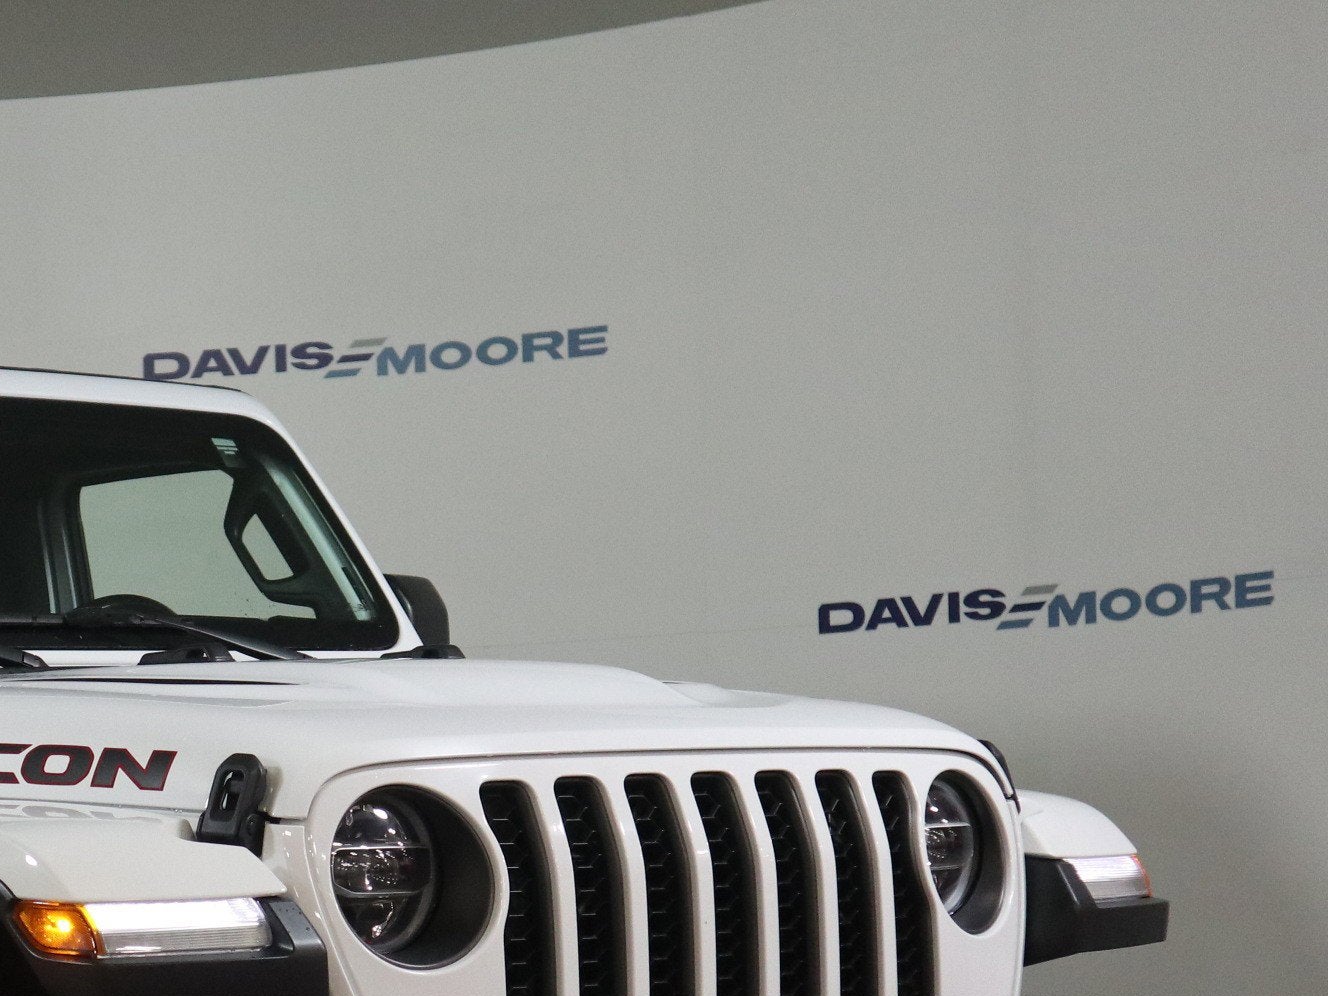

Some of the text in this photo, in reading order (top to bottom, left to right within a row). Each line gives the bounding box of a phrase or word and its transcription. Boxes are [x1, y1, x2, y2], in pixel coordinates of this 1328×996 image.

[142, 325, 609, 381] DAVIS MOORE
[818, 570, 1275, 635] DAVIS MOORE
